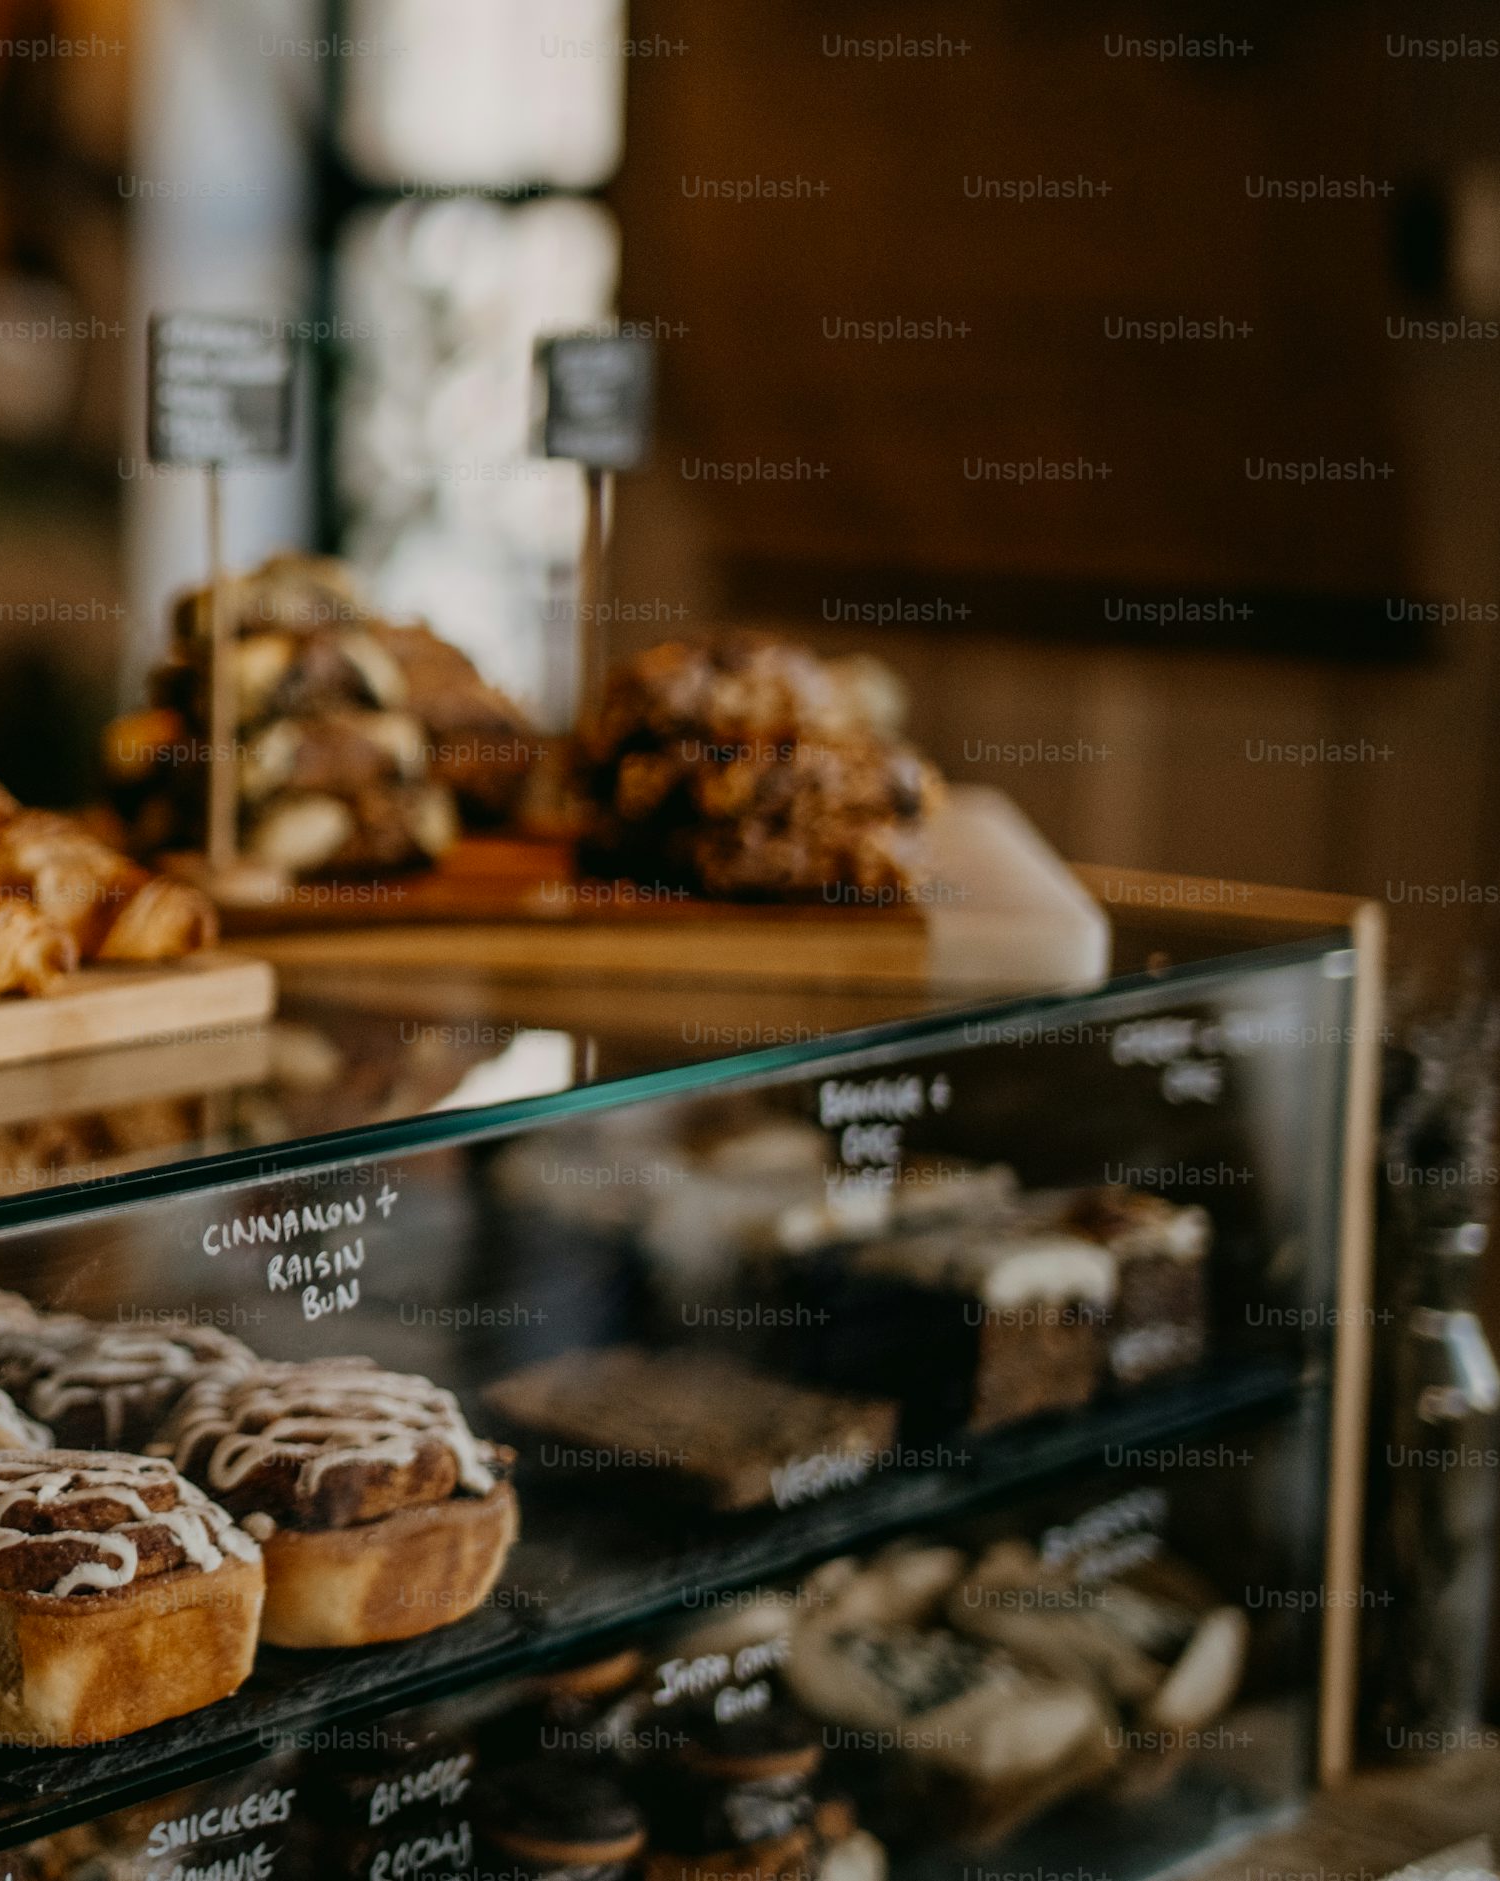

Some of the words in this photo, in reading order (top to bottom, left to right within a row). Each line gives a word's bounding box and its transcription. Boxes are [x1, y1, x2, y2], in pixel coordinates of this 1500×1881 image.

[202, 1195, 366, 1256] CINNAMON
[267, 1237, 365, 1292] RAISIN
[302, 1278, 360, 1321] BUN
[147, 1788, 297, 1857] SNICKERS
